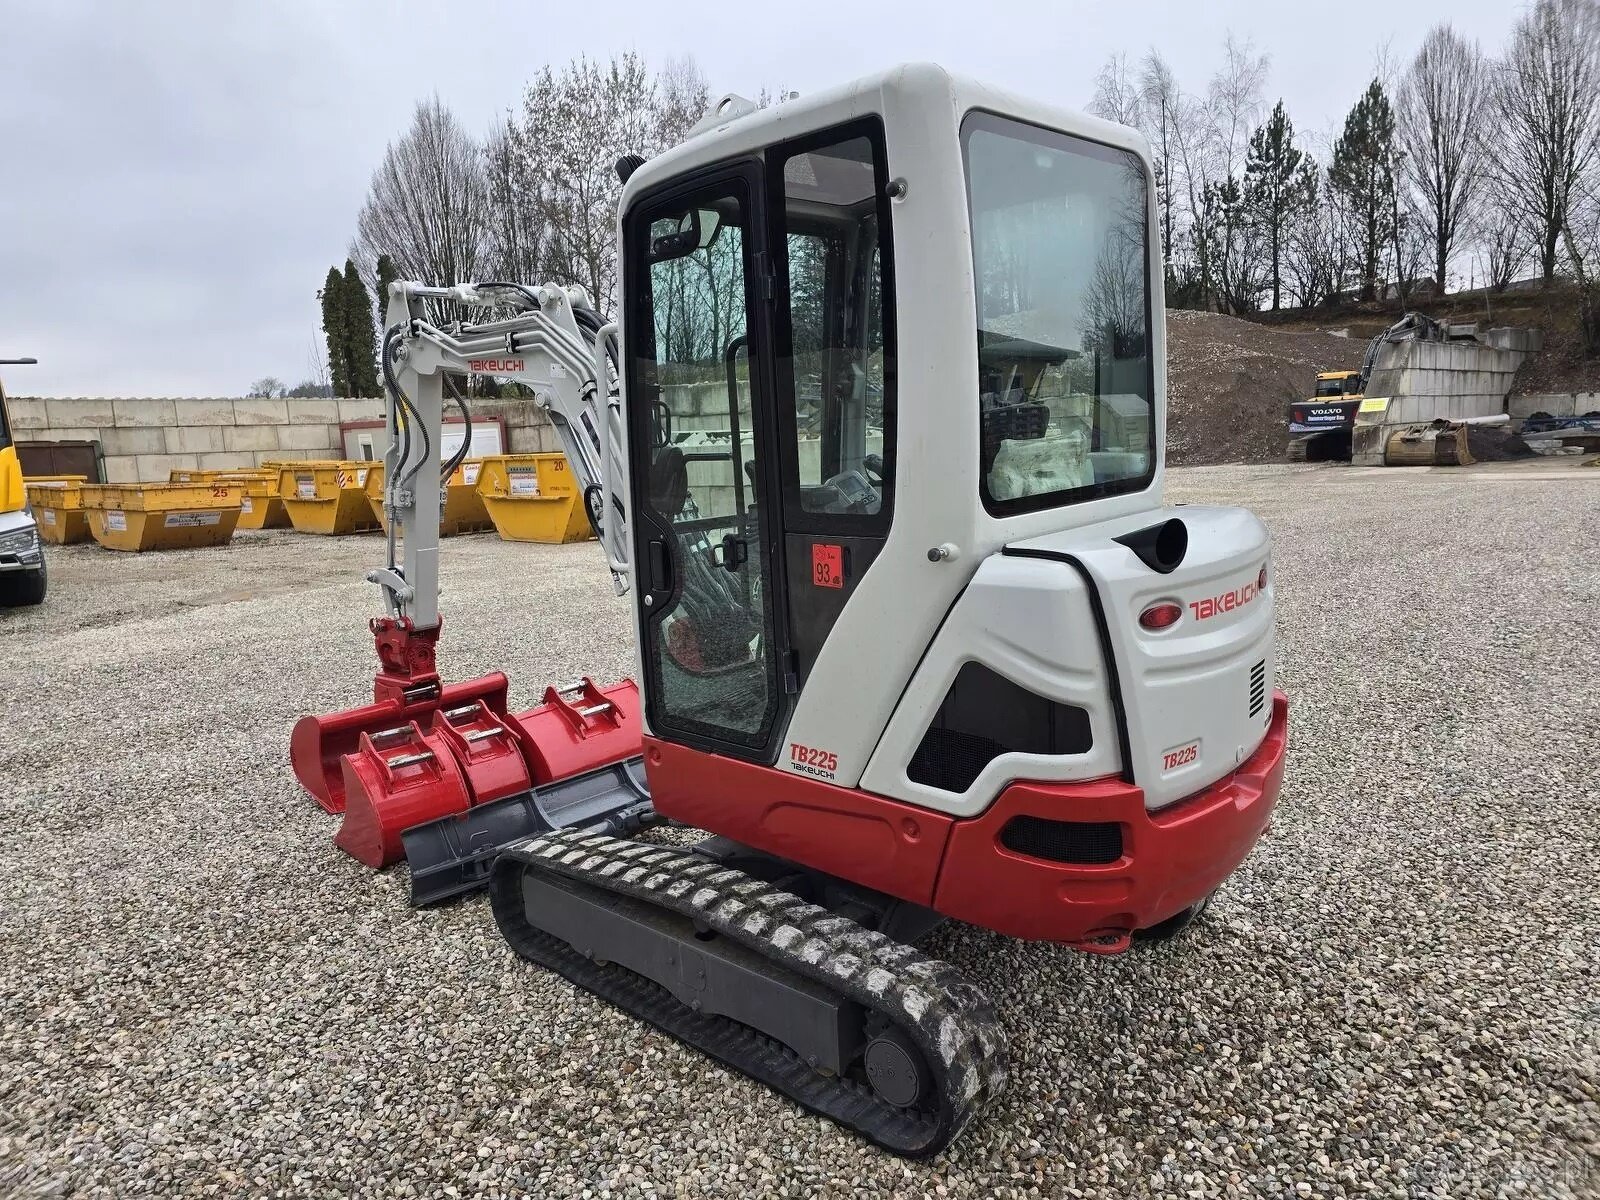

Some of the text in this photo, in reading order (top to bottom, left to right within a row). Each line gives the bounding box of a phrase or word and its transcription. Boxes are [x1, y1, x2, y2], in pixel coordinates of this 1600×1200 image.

[553, 461, 564, 471] 20
[346, 476, 353, 484] 4
[213, 488, 228, 498] 25
[816, 562, 831, 583] 93
[790, 743, 838, 772] TB225
[1163, 744, 1198, 770] TB225
